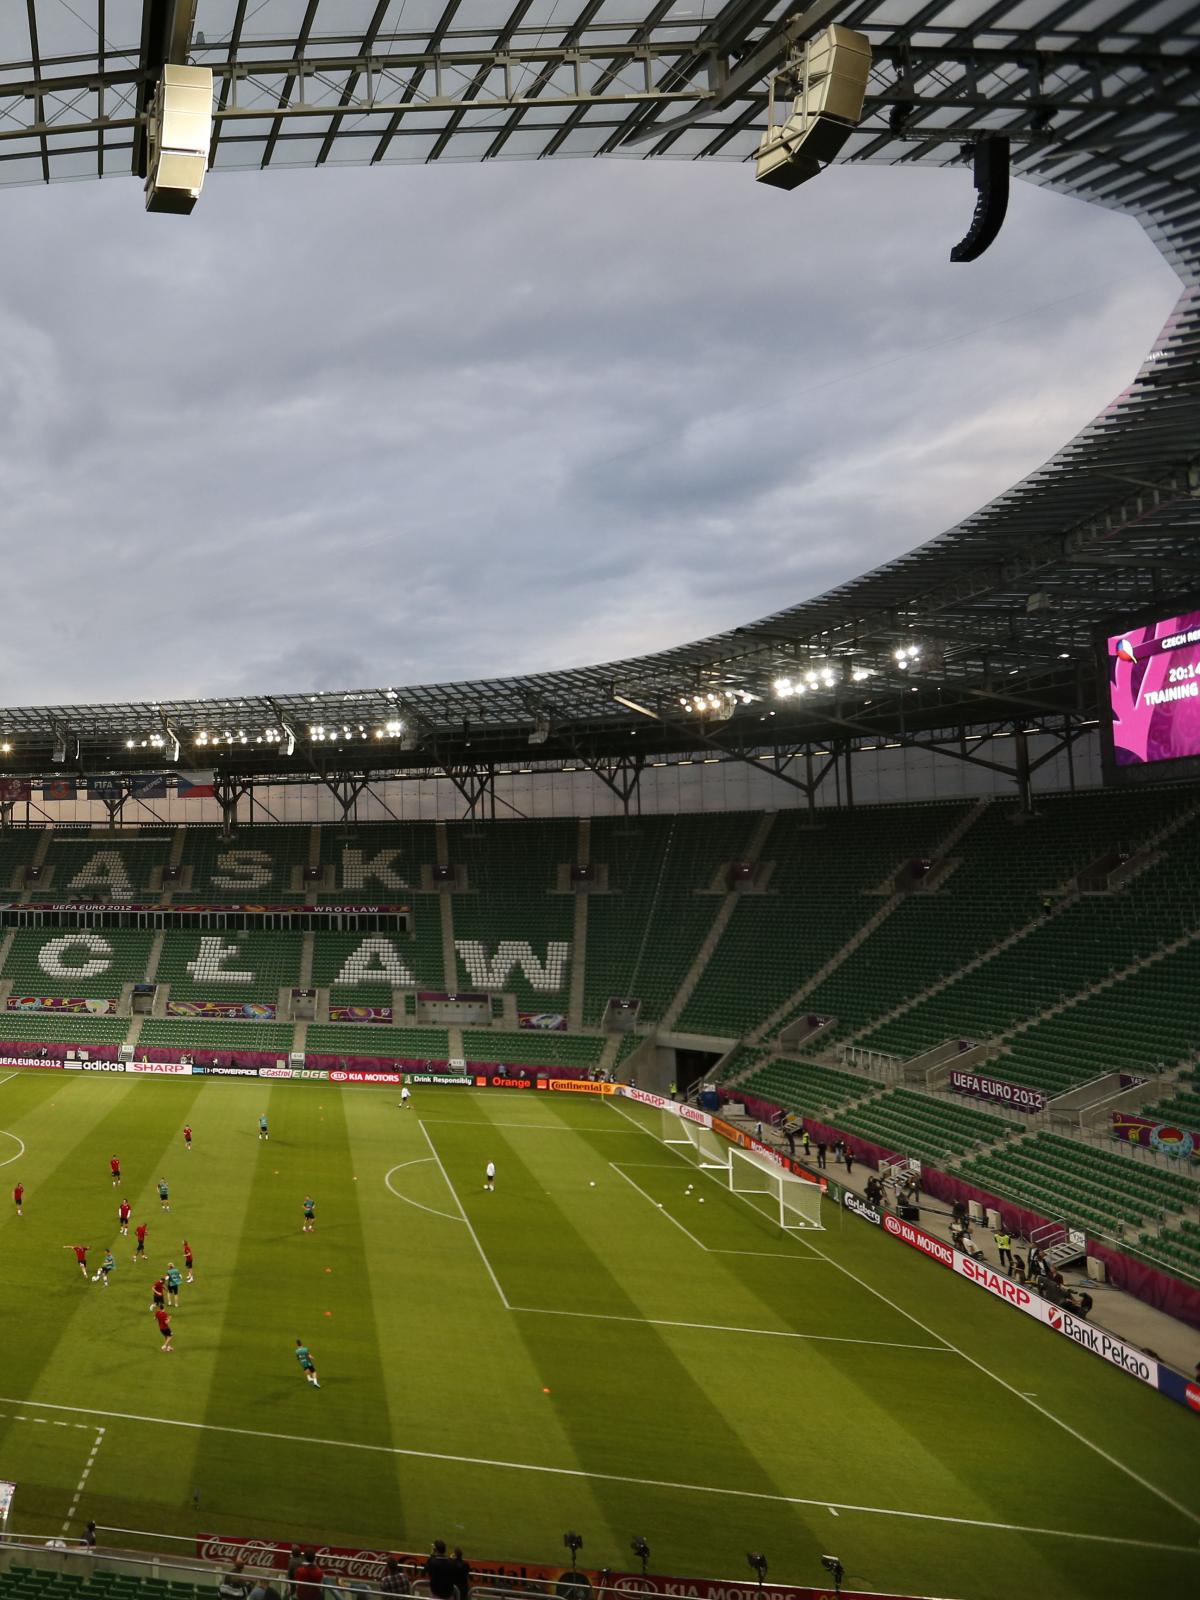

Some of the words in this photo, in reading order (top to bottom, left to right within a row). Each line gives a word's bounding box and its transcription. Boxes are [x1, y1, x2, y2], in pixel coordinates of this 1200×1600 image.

[1143, 682, 1199, 706] TRAINING
[94, 781, 112, 789] FIFA
[52, 904, 78, 912] UEFA
[79, 904, 105, 912] EURO
[314, 906, 380, 914] WROCLAW
[40, 1059, 61, 1067] 2012
[83, 1060, 124, 1072] adidas
[133, 1063, 184, 1073] SHARP
[213, 1067, 257, 1075] POWERADE
[265, 1068, 291, 1077] Castrol
[292, 1069, 328, 1078] EDGE
[349, 1072, 363, 1080] KIA
[365, 1073, 400, 1082] MOTORS
[414, 1075, 432, 1084] Drink
[433, 1076, 472, 1086] Responsibly
[492, 1076, 531, 1087] Orange
[551, 1081, 602, 1092] Continental
[953, 1072, 980, 1092] UEFA
[981, 1080, 1012, 1099] EURO
[1013, 1089, 1043, 1109] 2012
[631, 1089, 665, 1107] SHARP
[680, 1105, 705, 1123] Canon
[844, 1191, 881, 1224] Carlsberg
[887, 1218, 899, 1232] KIA
[902, 1226, 916, 1242] KIA
[917, 1235, 953, 1264] MOTORS
[962, 1258, 1031, 1306] SHARP
[1063, 1314, 1099, 1353] Bank
[1102, 1335, 1150, 1380] Pekao
